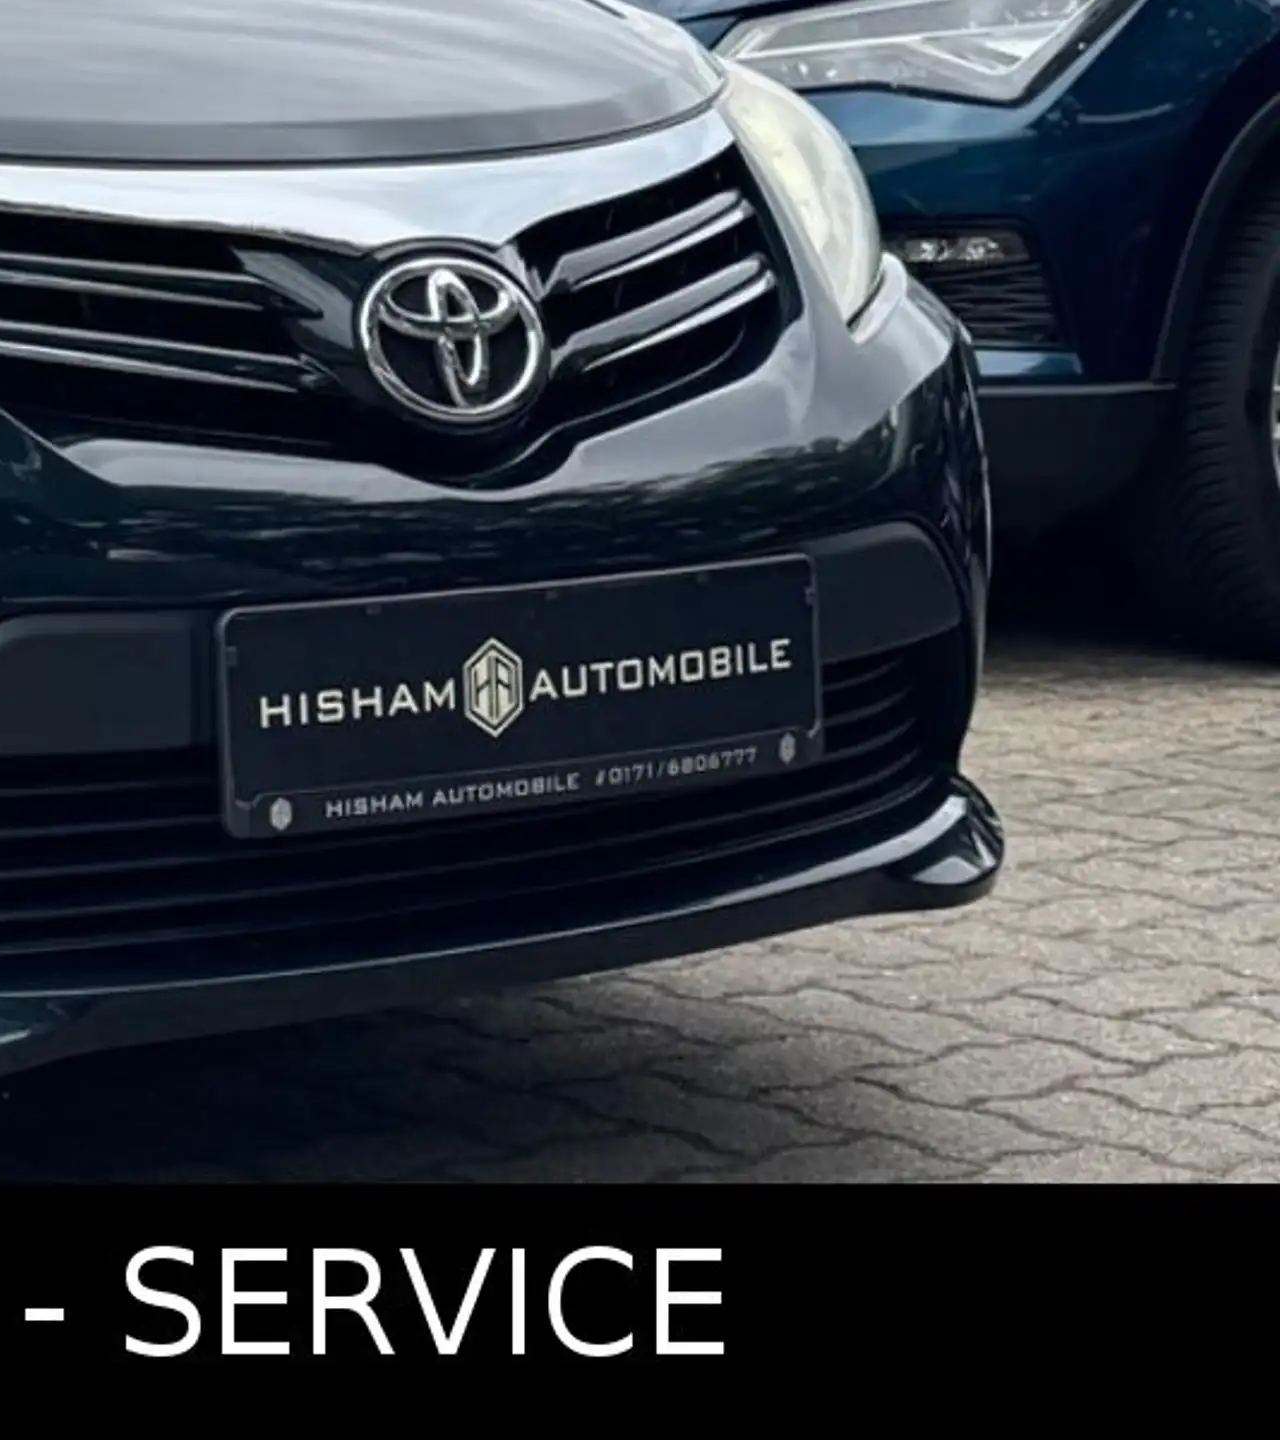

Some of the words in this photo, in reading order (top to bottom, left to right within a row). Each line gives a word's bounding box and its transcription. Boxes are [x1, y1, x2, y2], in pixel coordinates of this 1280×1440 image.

[259, 676, 457, 729] HISHAM
[528, 637, 793, 703] AUTOMOBILE
[324, 790, 425, 819] HISHAM
[431, 771, 582, 808] AUTOMOBILE
